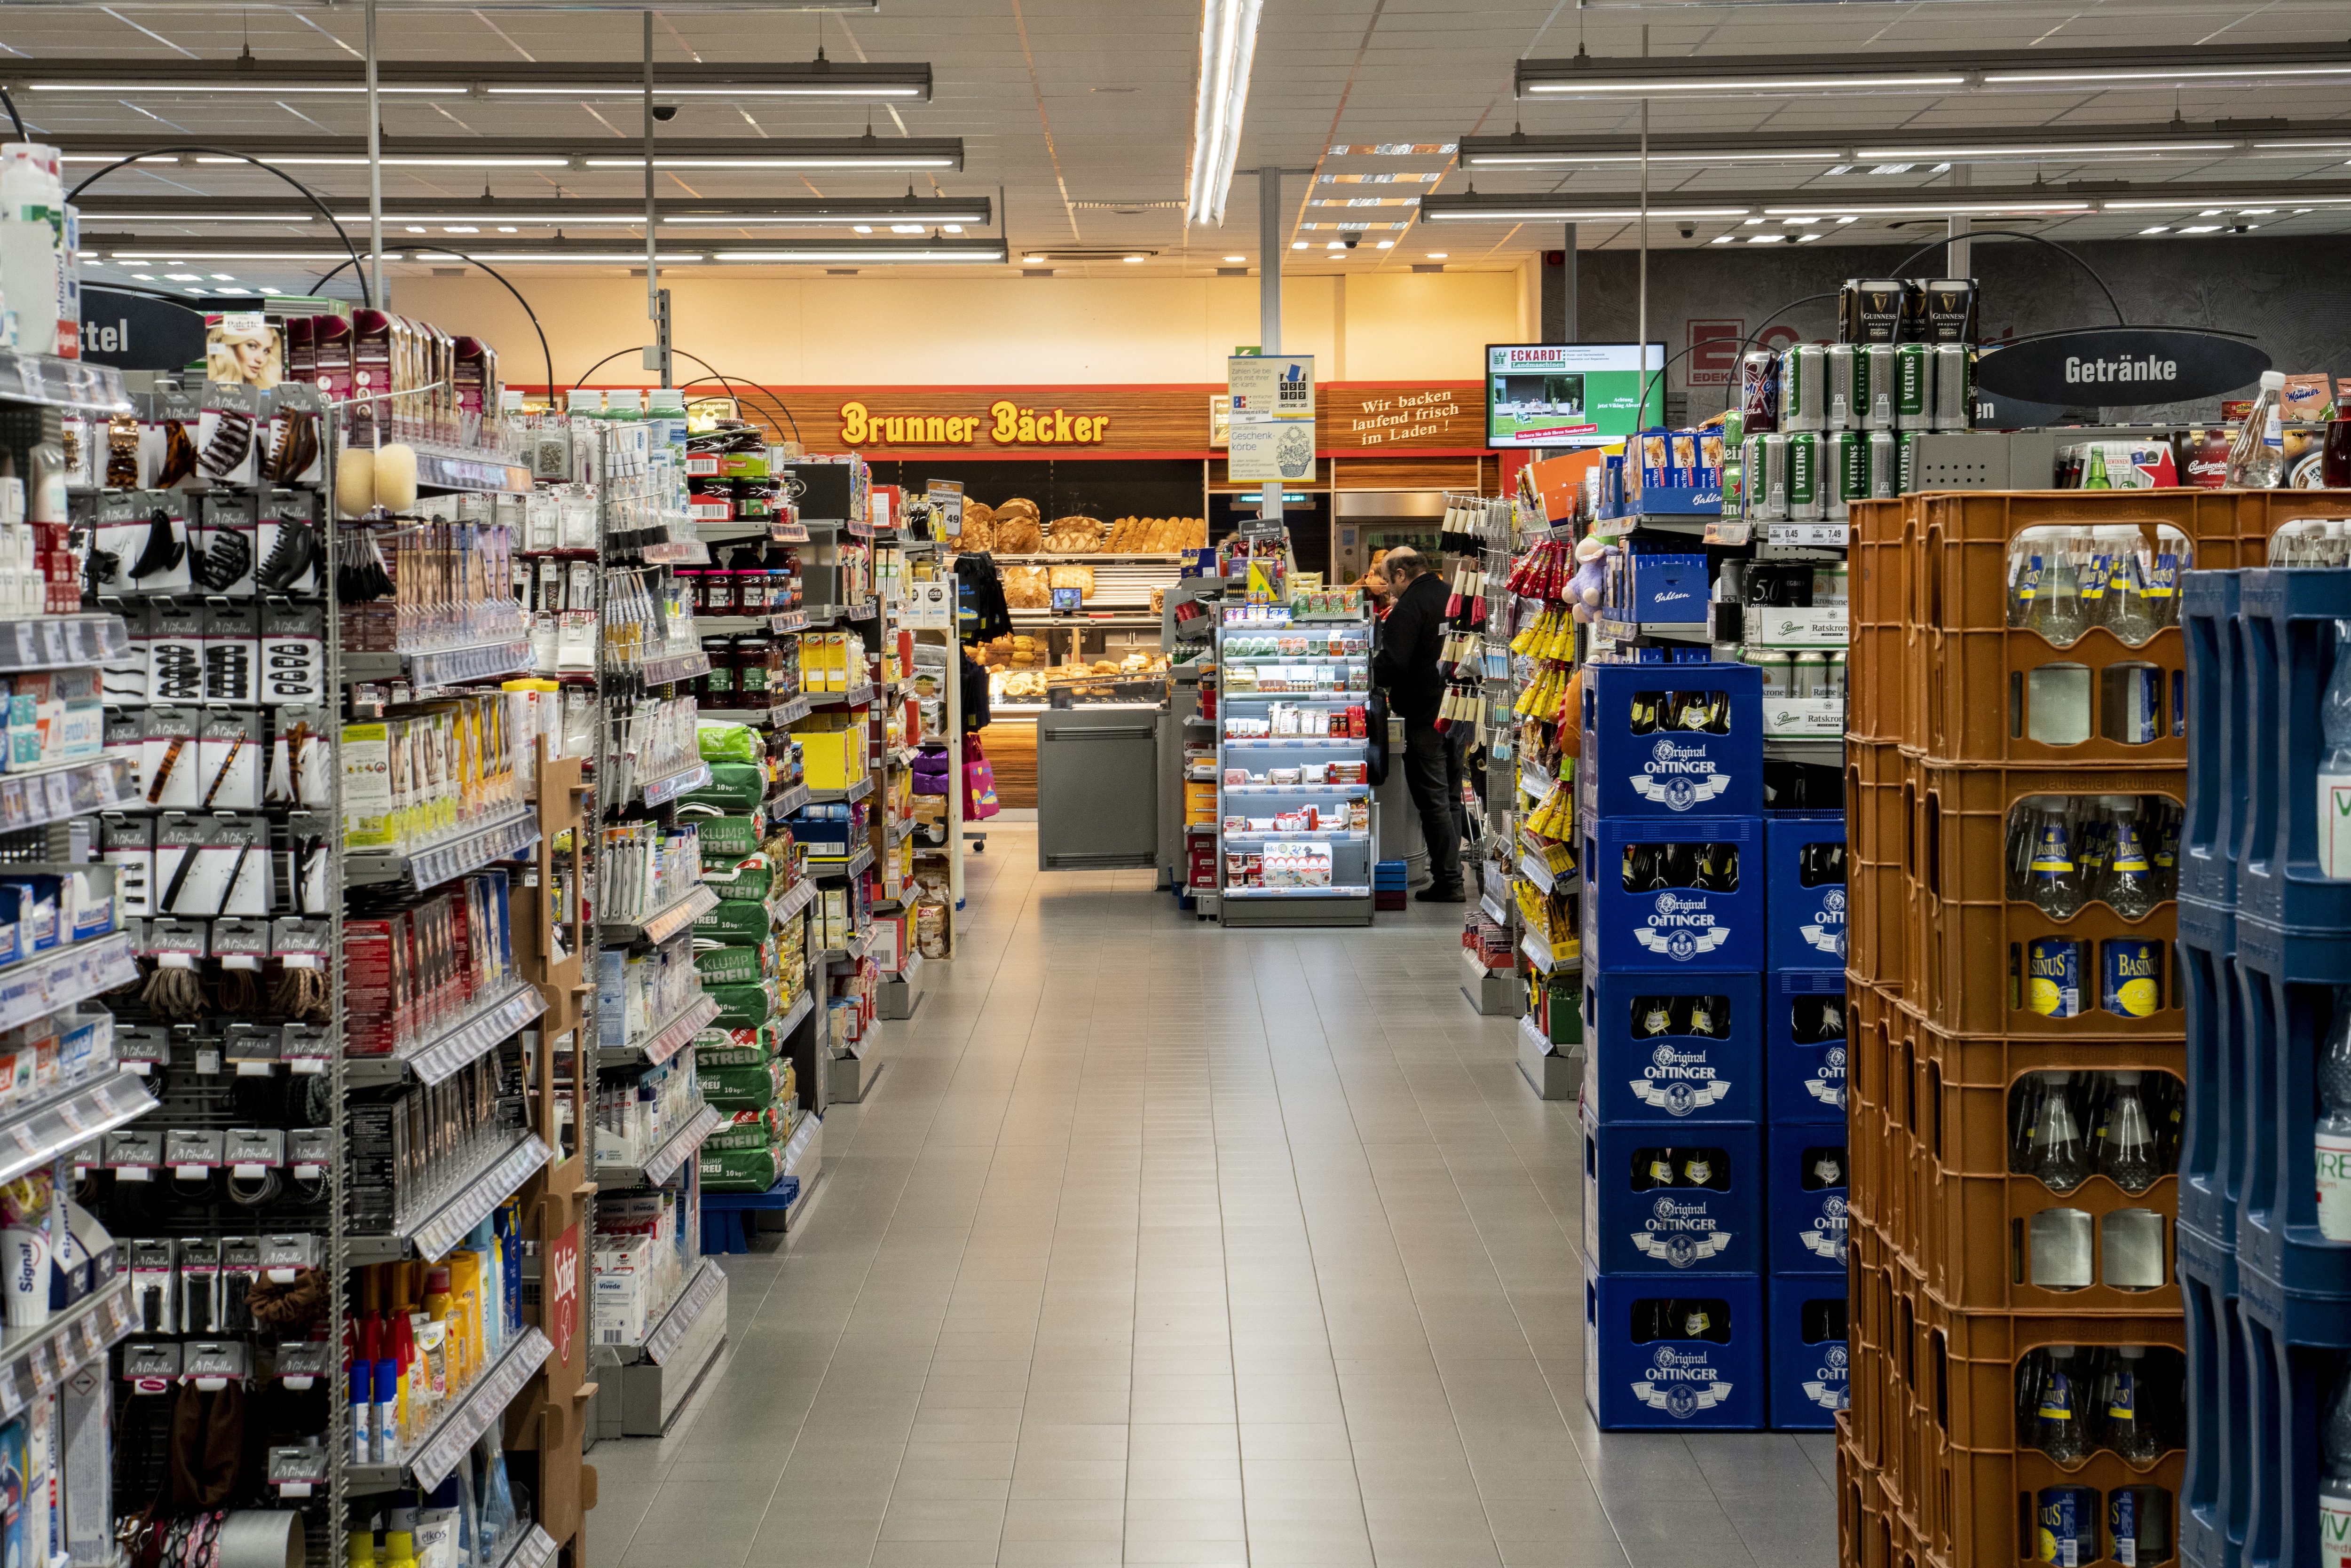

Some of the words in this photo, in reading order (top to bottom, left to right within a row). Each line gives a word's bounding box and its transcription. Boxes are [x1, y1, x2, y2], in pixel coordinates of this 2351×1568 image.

[228, 320, 260, 328] Palette
[1511, 349, 1562, 361] ECKARDT
[1693, 373, 1738, 382] EDEKA
[1904, 355, 1915, 400] VELTINS
[2065, 355, 2177, 384] Getränke
[1361, 399, 1392, 414] Wir
[1398, 391, 1452, 408] backen
[2285, 388, 2321, 403] Manner
[2236, 402, 2252, 412] shoi
[839, 400, 981, 446] Brunner
[989, 399, 1111, 446] Bäcker
[1352, 410, 1409, 432] laufend
[1415, 403, 1459, 421] frisch
[1231, 432, 1275, 440] Geschenk-
[1361, 433, 1382, 446] im
[1389, 425, 1437, 441] Laden
[1796, 445, 1806, 490] VELTINS
[1849, 445, 1858, 489] VELTINS
[947, 514, 959, 523] 49
[1785, 529, 1798, 538] 0.45
[1828, 529, 1841, 538] 7.49
[1654, 591, 1690, 603] Bahlsen
[1752, 579, 1779, 601] 5,0
[1778, 621, 1805, 637] Pilsener
[1774, 711, 1800, 727] Pilsener
[1652, 739, 1706, 762] Original
[701, 827, 746, 840] KLUMP
[2036, 842, 2067, 857] BASINUS
[1655, 892, 1707, 914] Original
[704, 955, 749, 970] KLUMP
[697, 1049, 758, 1066] STREU
[1652, 1044, 1707, 1068] Original
[1653, 1196, 1707, 1220] Original
[19, 1243, 33, 1293] Signal
[554, 1247, 576, 1303] Schär
[423, 1330, 441, 1340] elkos
[1653, 1345, 1708, 1369] Original
[421, 1528, 447, 1543] elkos
